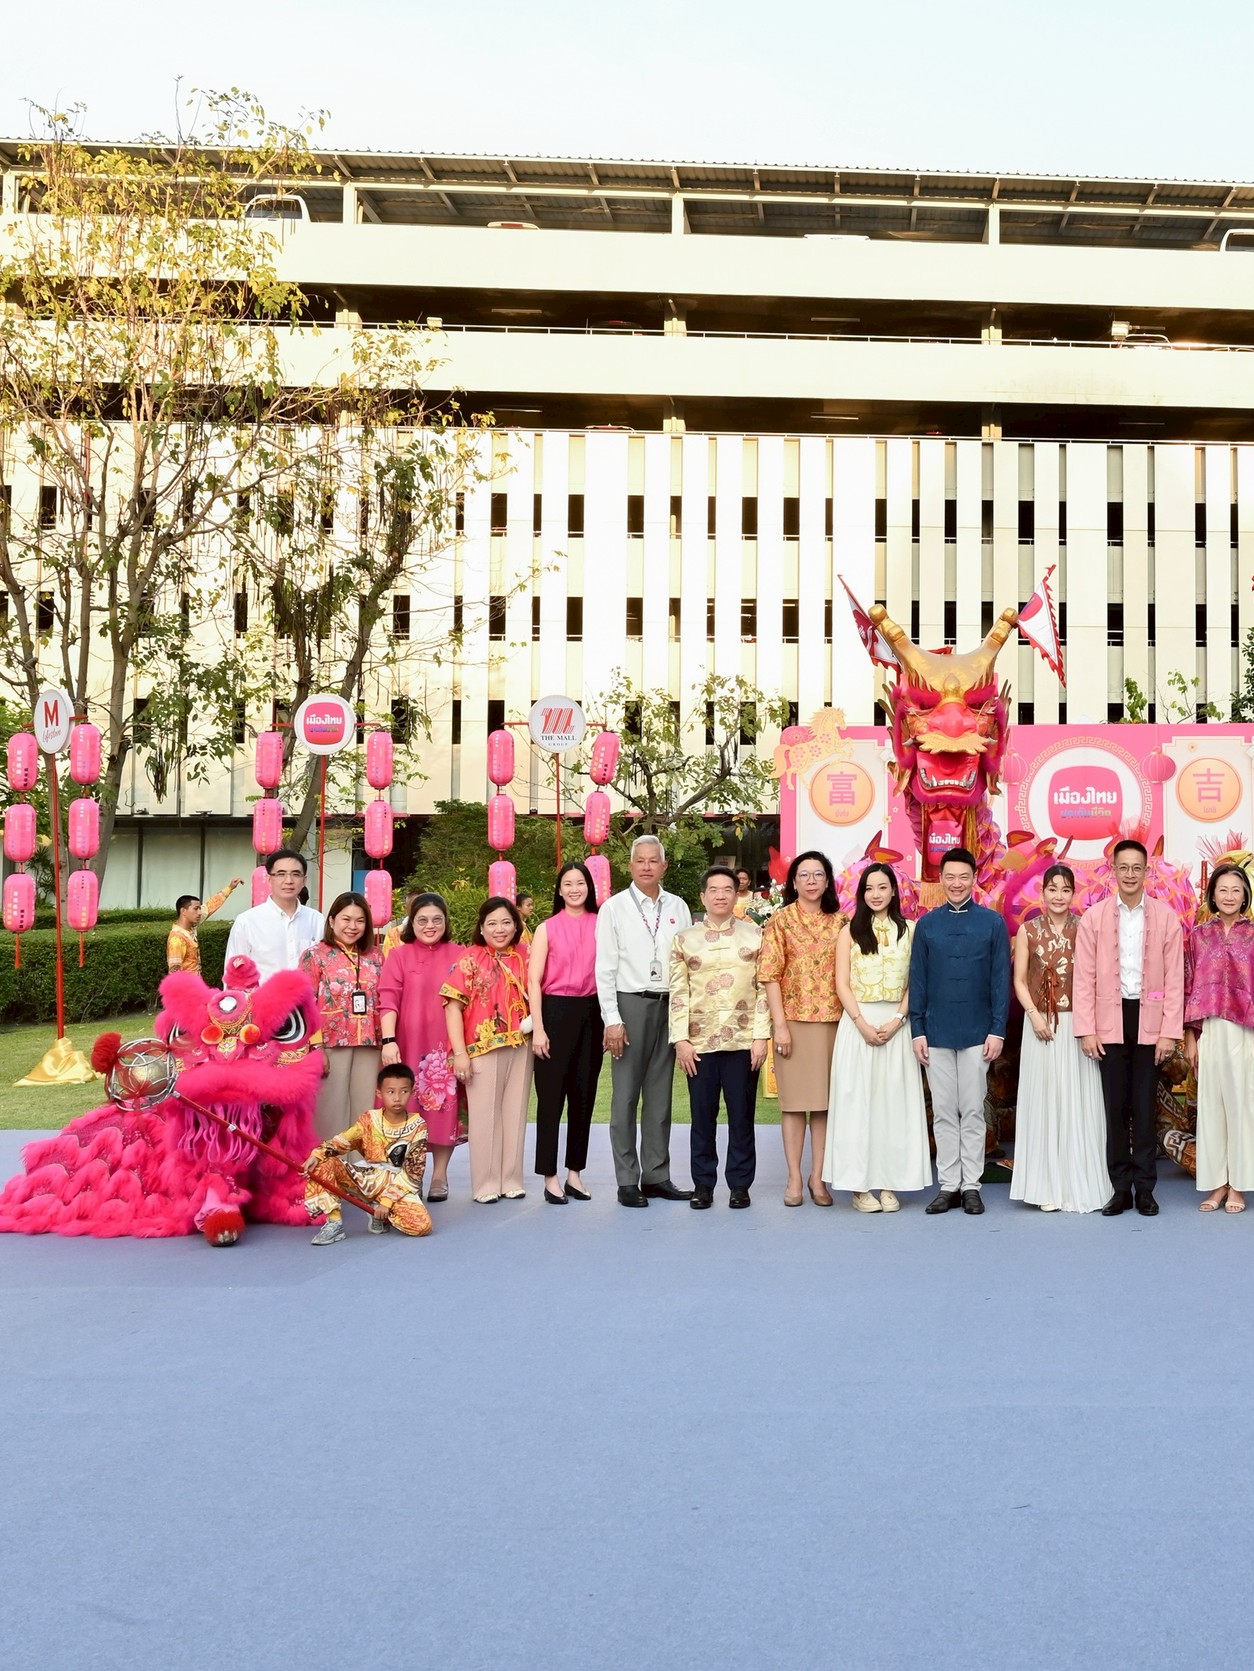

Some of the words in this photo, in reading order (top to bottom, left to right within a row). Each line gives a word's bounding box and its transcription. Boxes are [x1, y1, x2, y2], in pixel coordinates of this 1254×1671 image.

[44, 699, 59, 728] M
[306, 713, 342, 725] เมืองไทย
[826, 770, 858, 807] 富
[1053, 785, 1117, 805] เมืองไทย
[1192, 767, 1226, 803] 吉
[928, 832, 961, 845] มืองไทย
